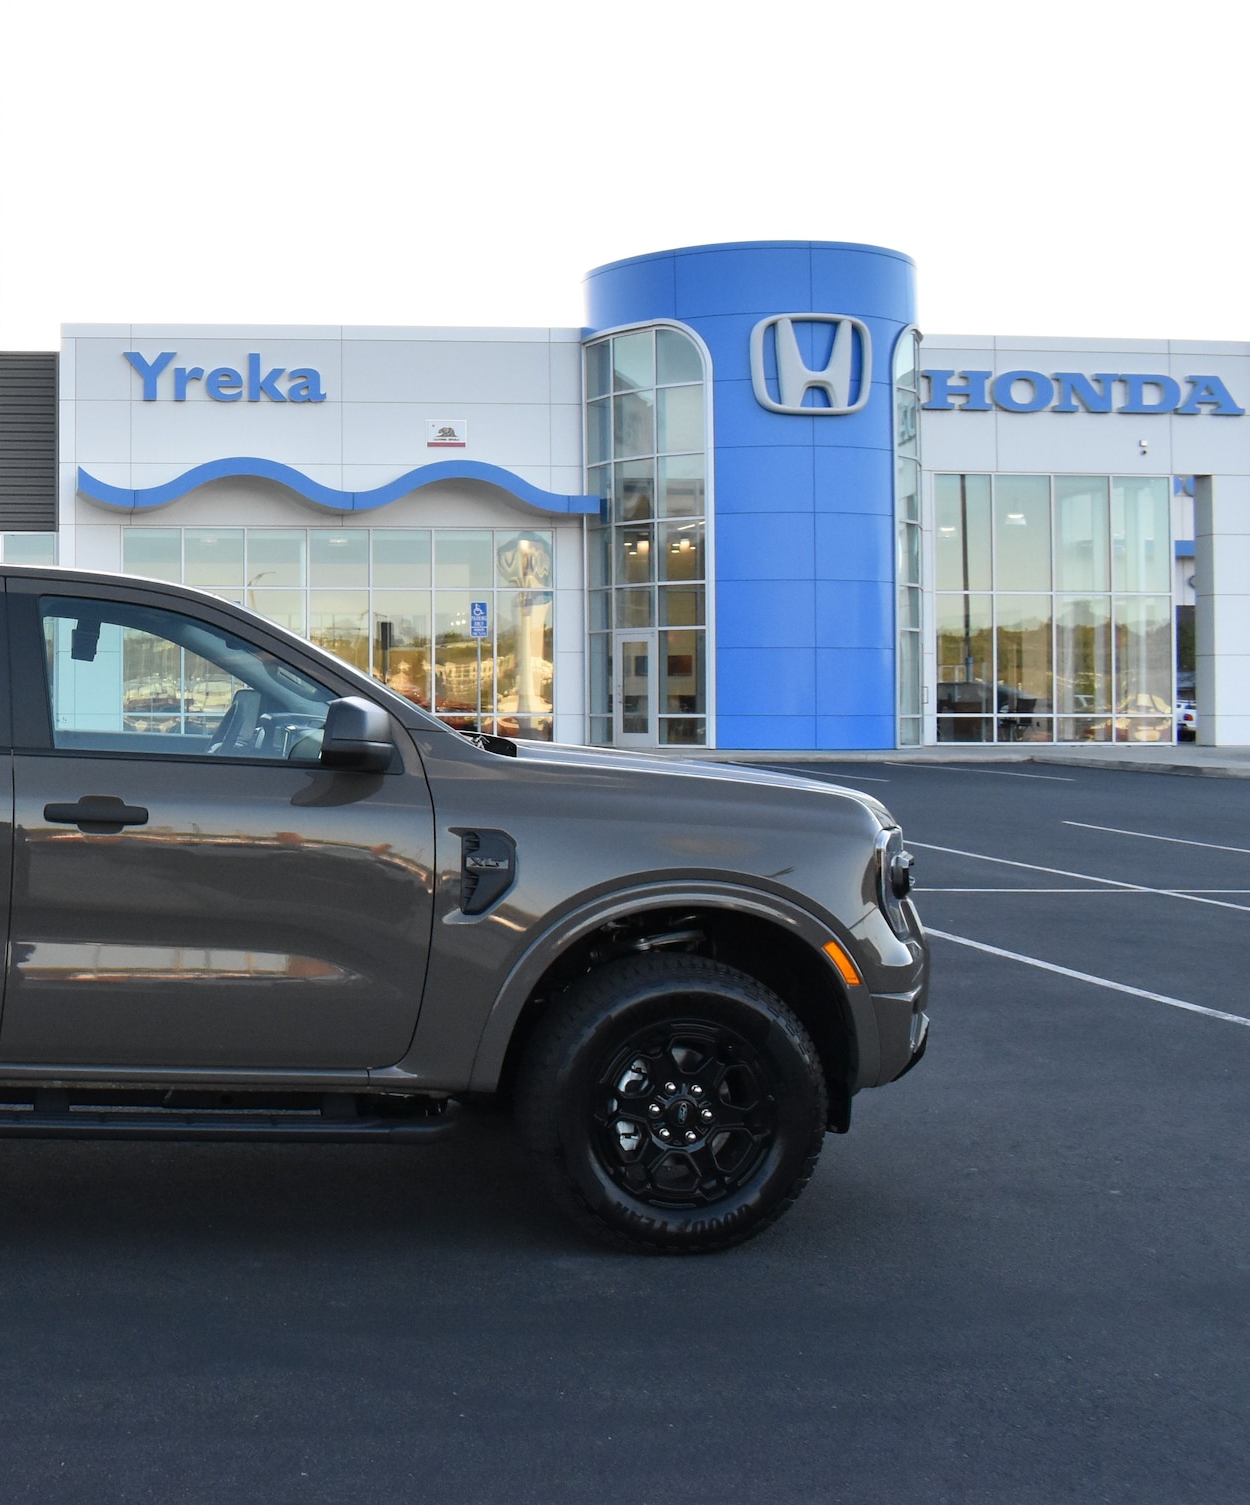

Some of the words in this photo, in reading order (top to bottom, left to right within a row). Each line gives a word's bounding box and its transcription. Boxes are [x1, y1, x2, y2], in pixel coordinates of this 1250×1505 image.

[123, 351, 327, 403] Yreka
[921, 369, 1246, 416] HONDA
[467, 857, 509, 869] XLT
